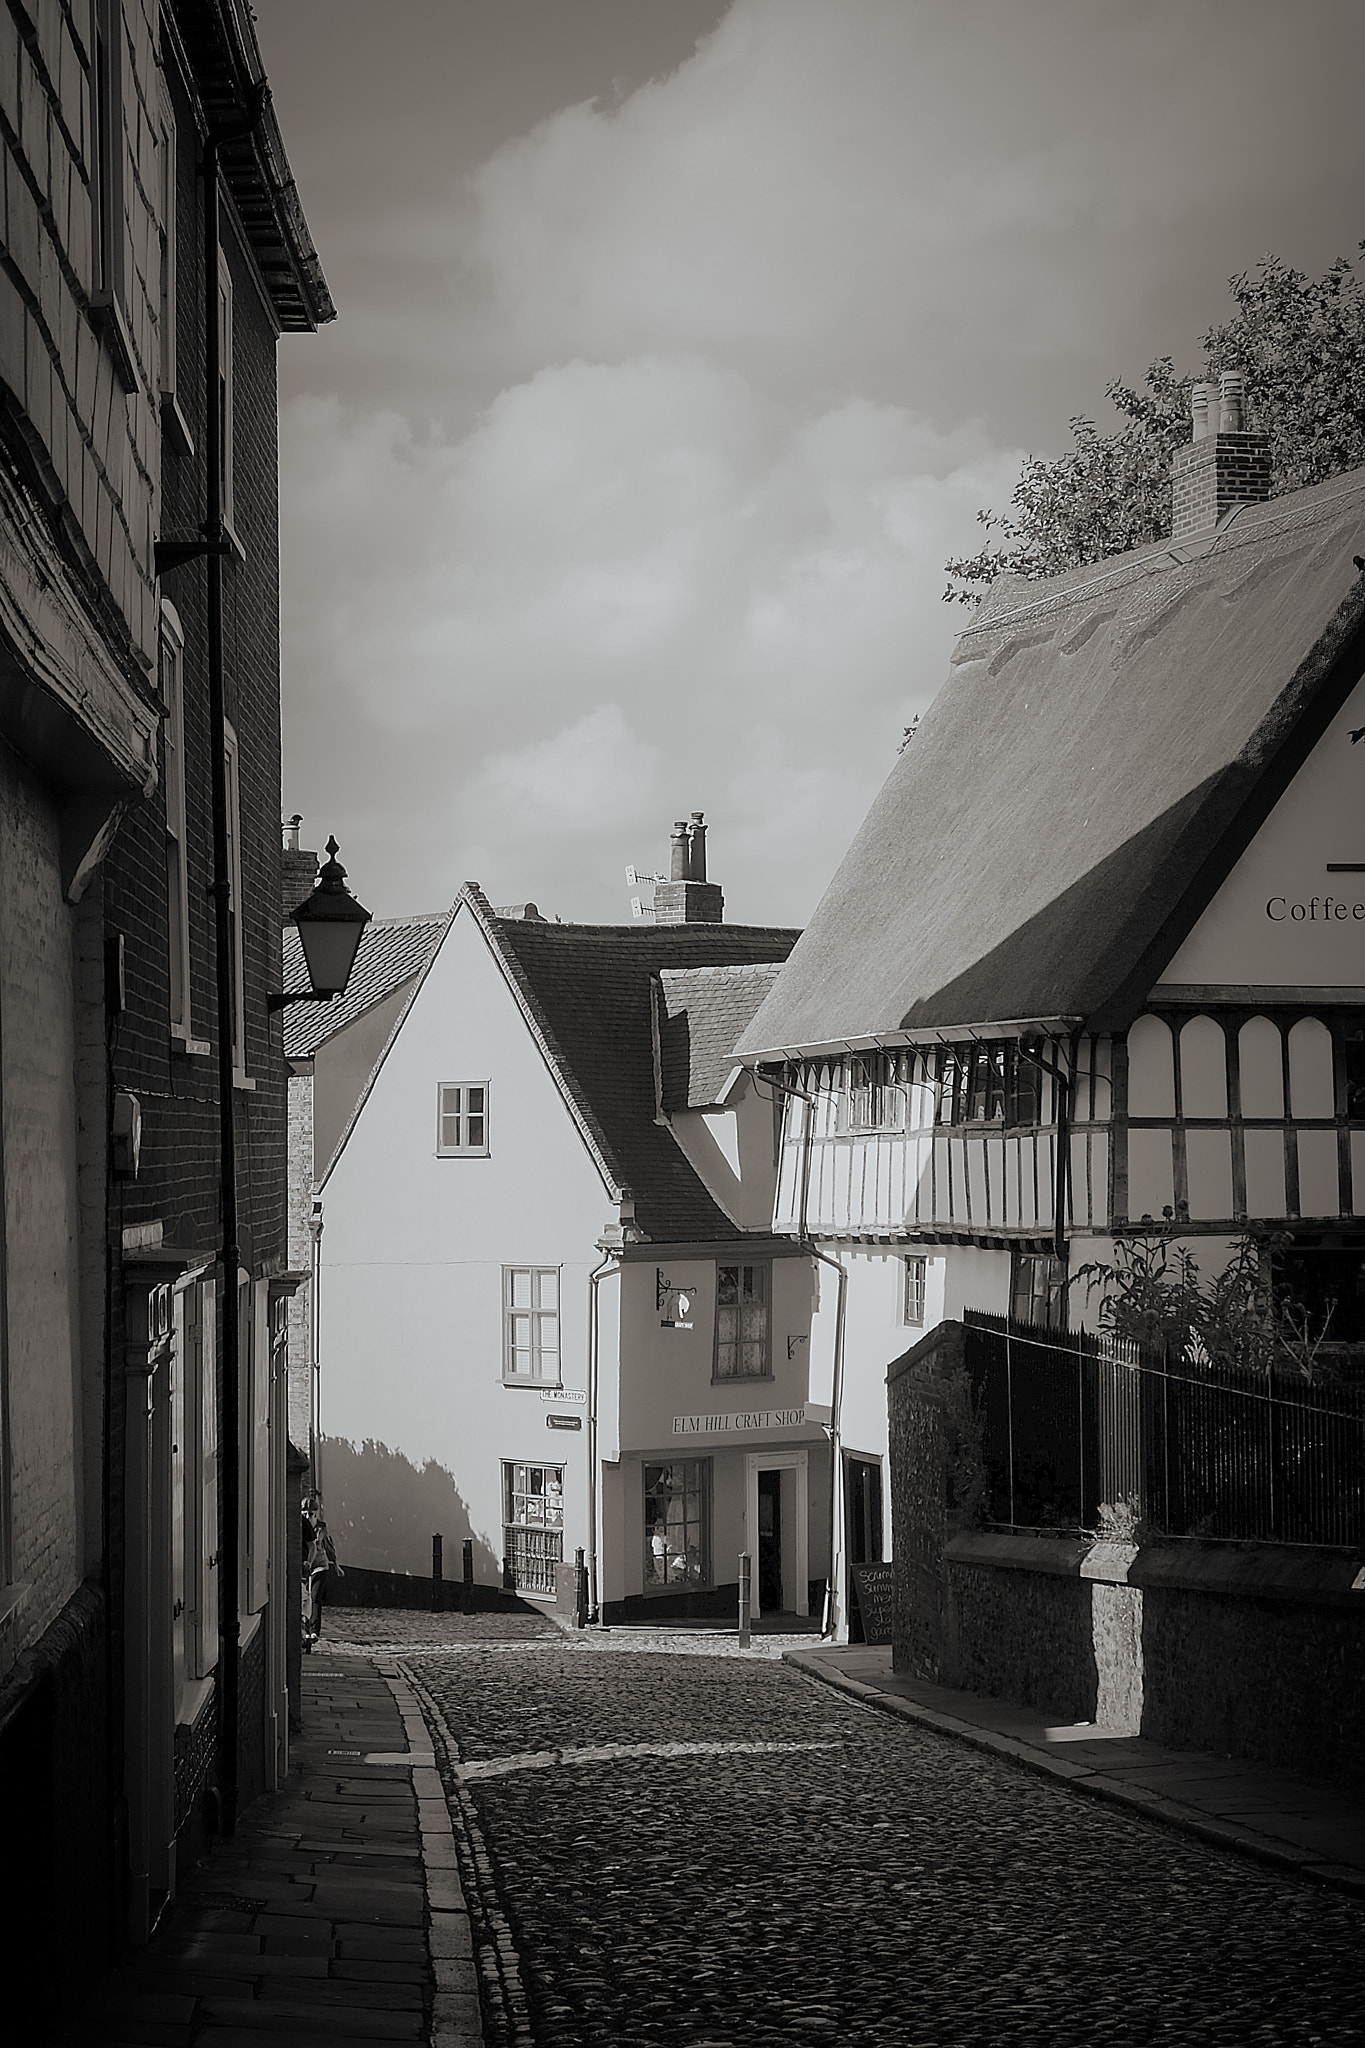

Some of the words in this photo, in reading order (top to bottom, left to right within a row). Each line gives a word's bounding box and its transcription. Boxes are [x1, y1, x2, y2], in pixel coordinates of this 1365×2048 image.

[1266, 896, 1365, 921] Coffee
[542, 1390, 552, 1399] THE
[554, 1391, 585, 1401] MONASTERY
[674, 1417, 700, 1433] ELM
[705, 1416, 731, 1431] HILL
[735, 1412, 771, 1429] CRAFT
[775, 1410, 805, 1426] SHOP
